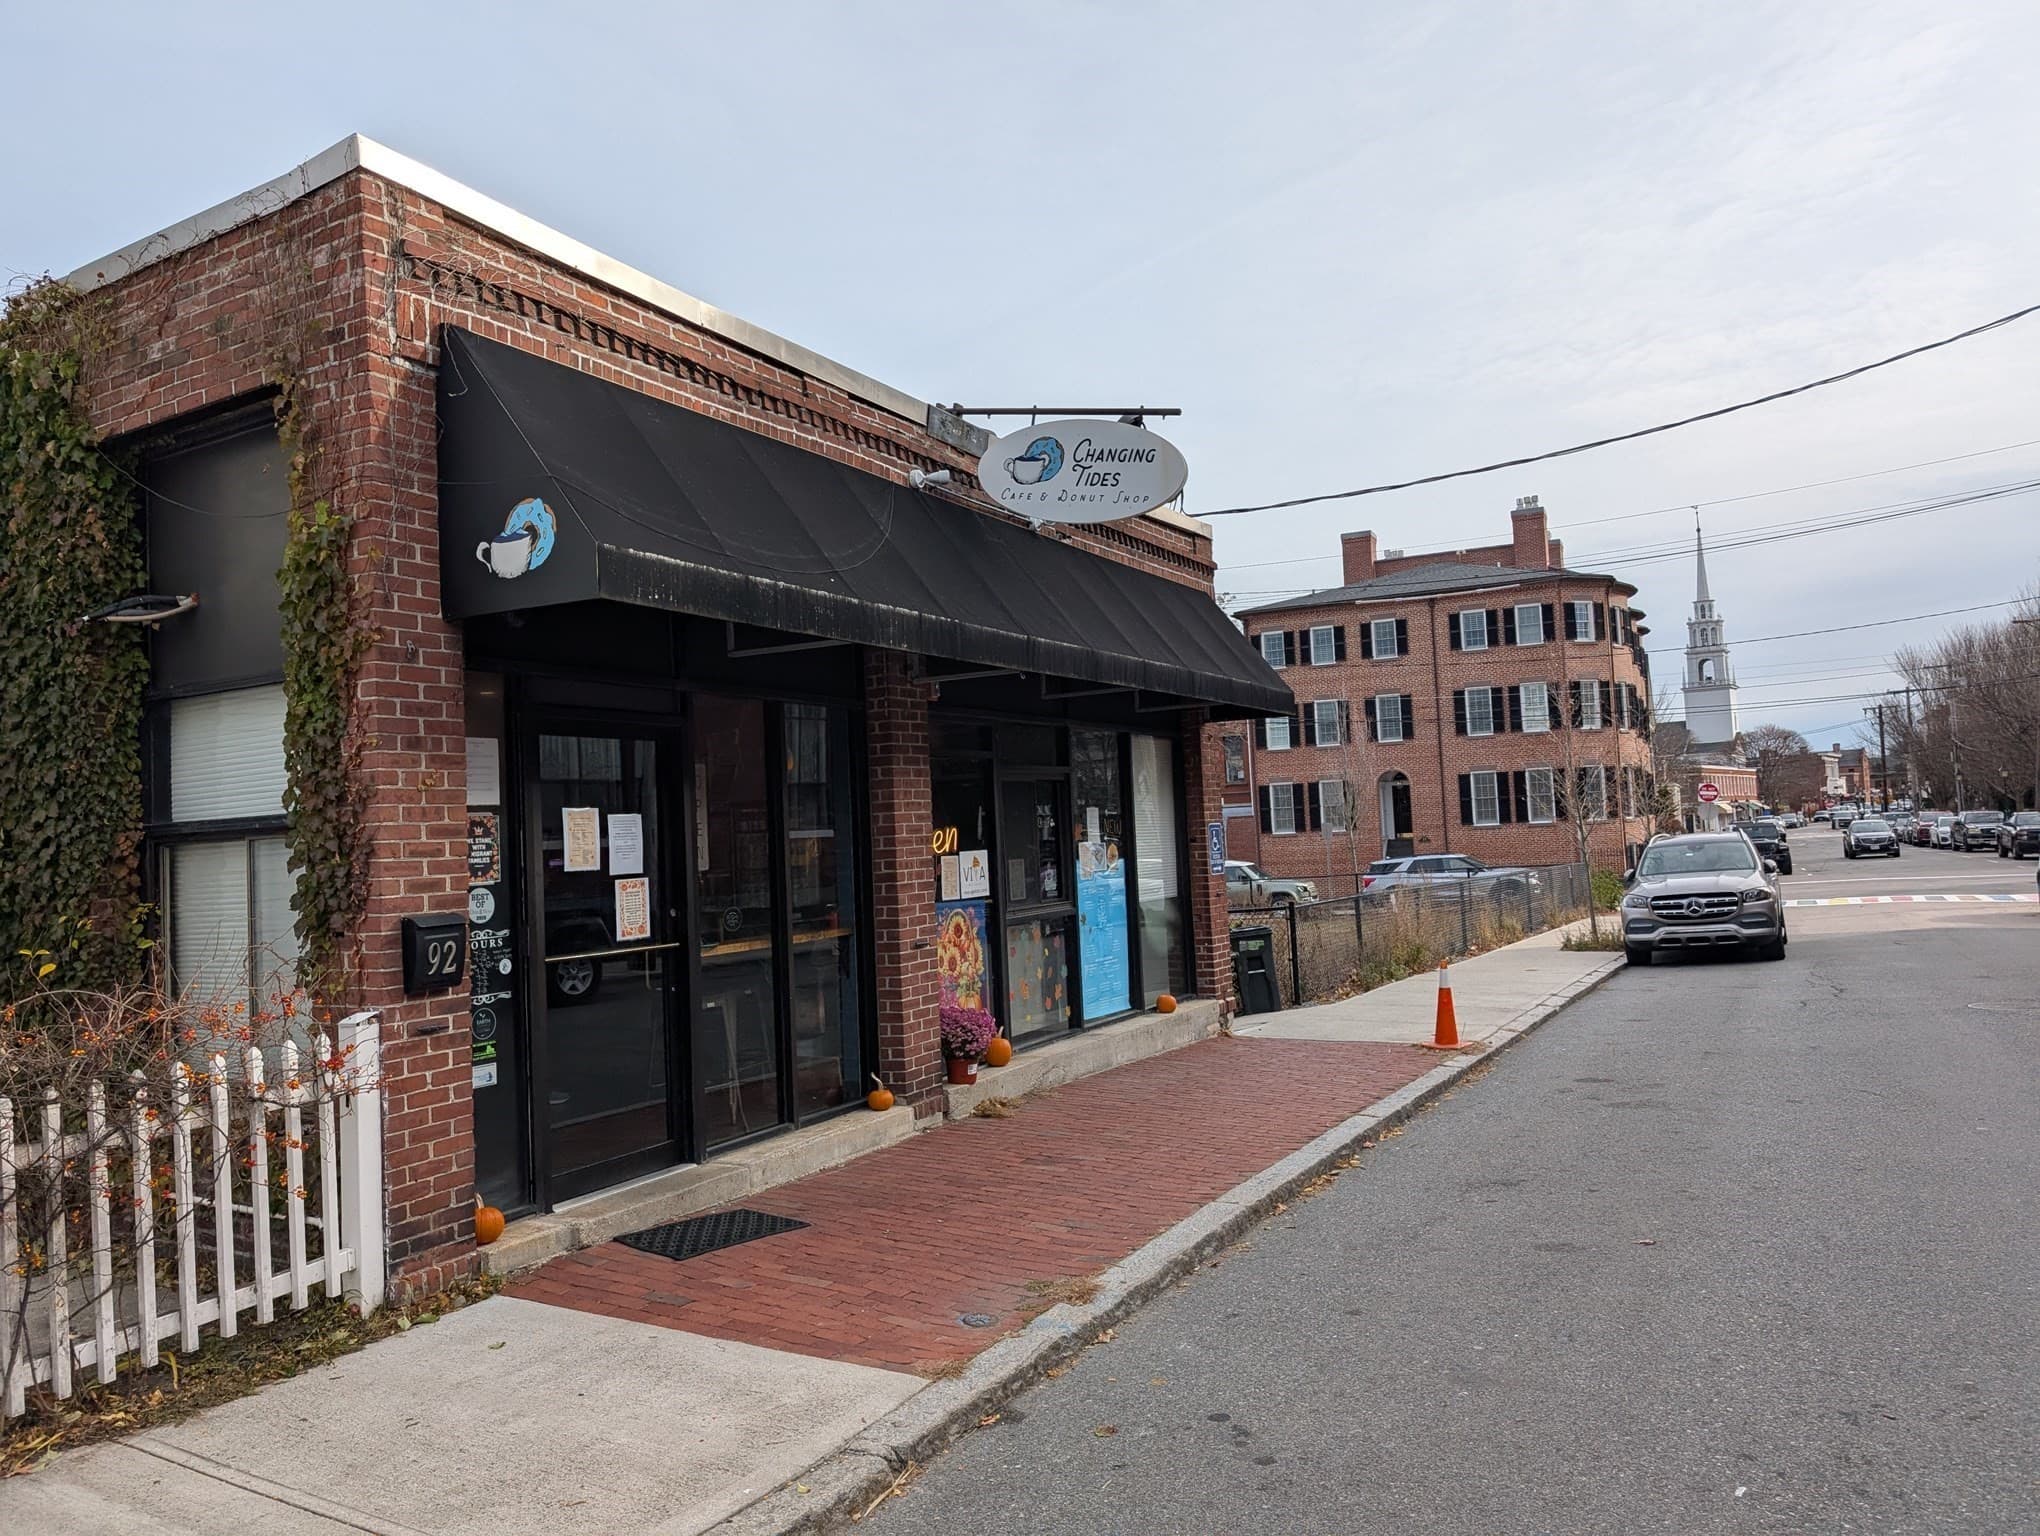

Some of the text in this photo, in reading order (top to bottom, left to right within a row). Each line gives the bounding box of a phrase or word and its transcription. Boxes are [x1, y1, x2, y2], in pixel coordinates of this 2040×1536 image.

[1073, 438, 1156, 464] CHANGING
[1072, 464, 1121, 487] TIDES
[1001, 488, 1152, 504] CAFE & DONUT SHOP
[471, 893, 489, 901] BEST
[475, 900, 486, 908] OF
[427, 940, 457, 975] 92
